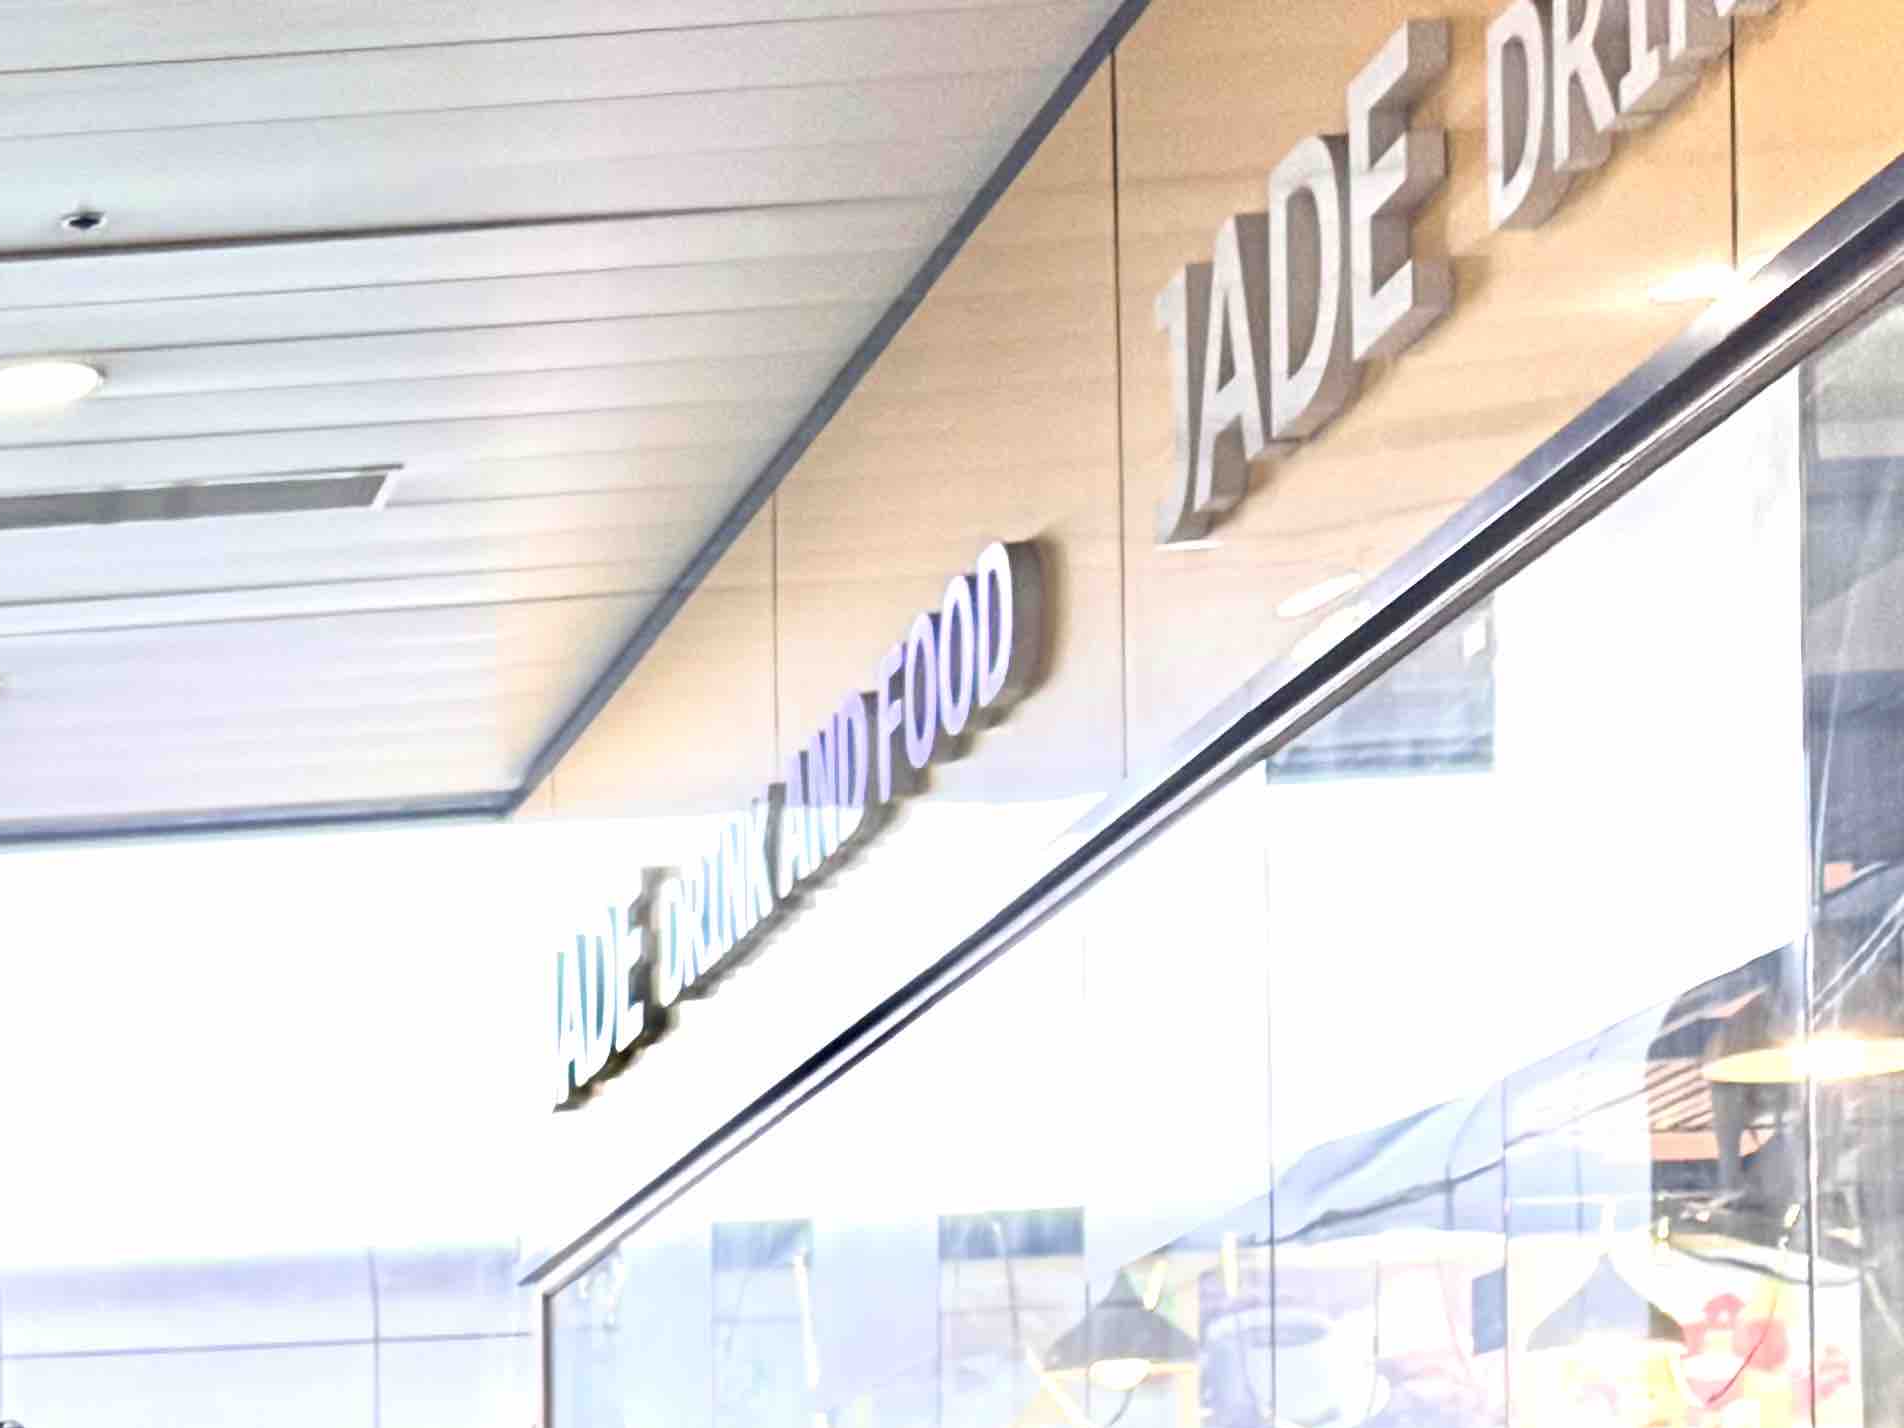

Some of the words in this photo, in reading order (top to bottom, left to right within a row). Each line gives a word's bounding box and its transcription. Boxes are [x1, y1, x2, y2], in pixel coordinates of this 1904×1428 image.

[1154, 20, 1414, 546] JADE
[553, 868, 645, 1110] JADE
[656, 785, 775, 1007] DRINK
[777, 691, 869, 900] AND
[879, 542, 1013, 803] FOOD
